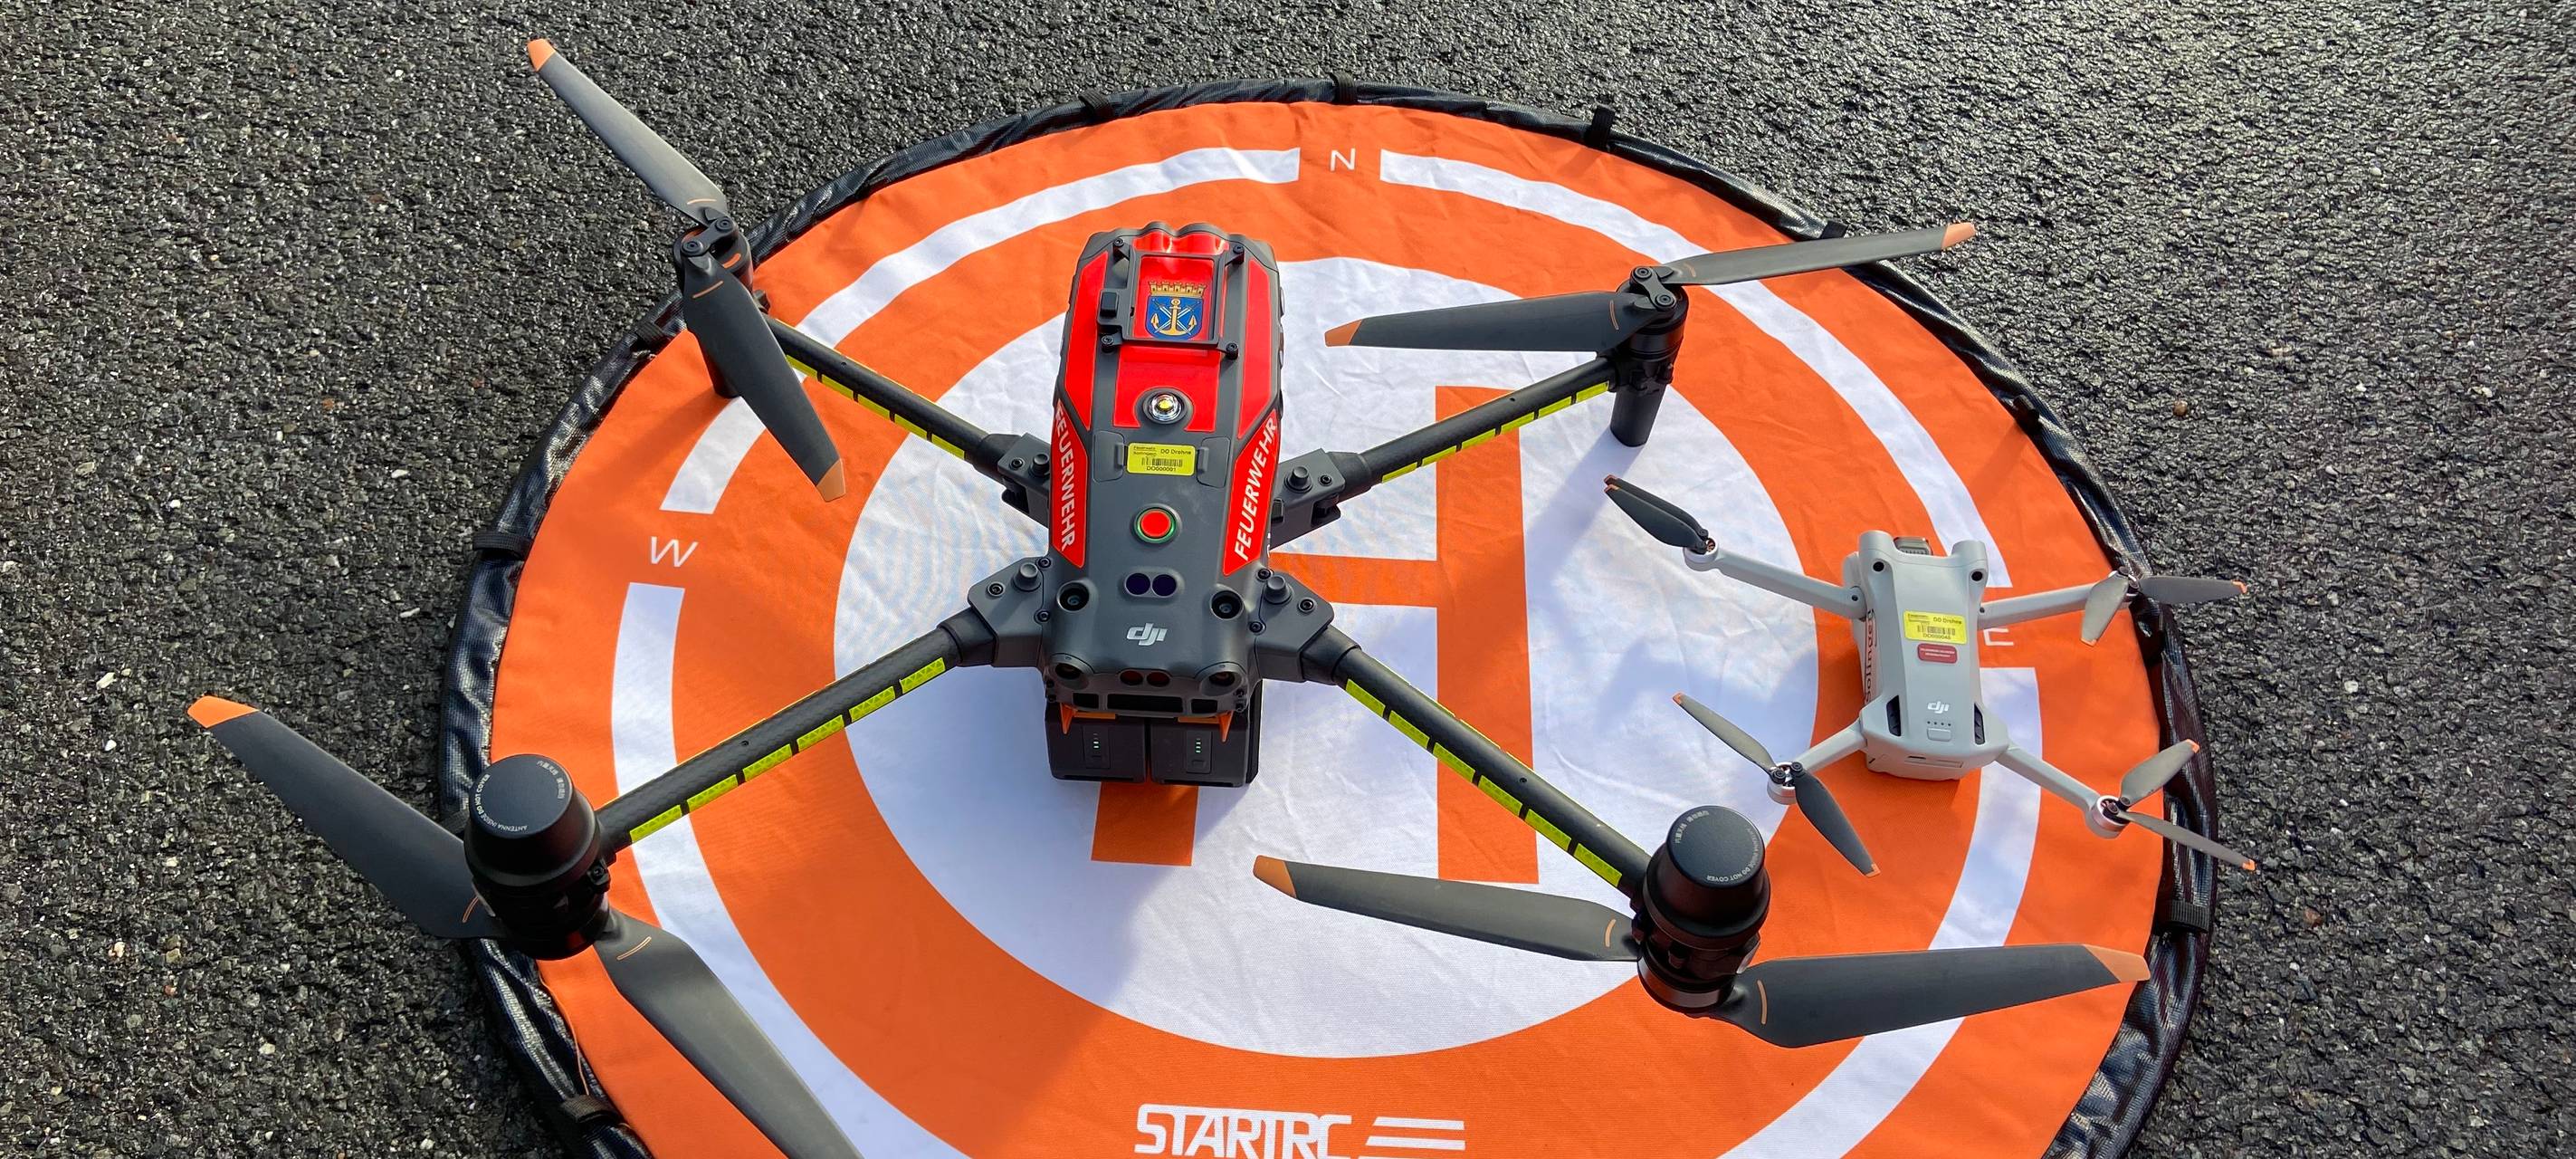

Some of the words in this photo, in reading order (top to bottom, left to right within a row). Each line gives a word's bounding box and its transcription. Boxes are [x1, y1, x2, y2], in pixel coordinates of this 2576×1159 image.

[1330, 148, 1357, 172] N
[1055, 403, 1075, 551] FEUERWEHR
[1234, 417, 1278, 561] FEUERWEHR
[650, 536, 700, 568] W
[476, 773, 491, 792] COVER
[476, 805, 485, 815] DO
[498, 823, 528, 832] ANTENNA
[1133, 1103, 1353, 1159] STARTRC
